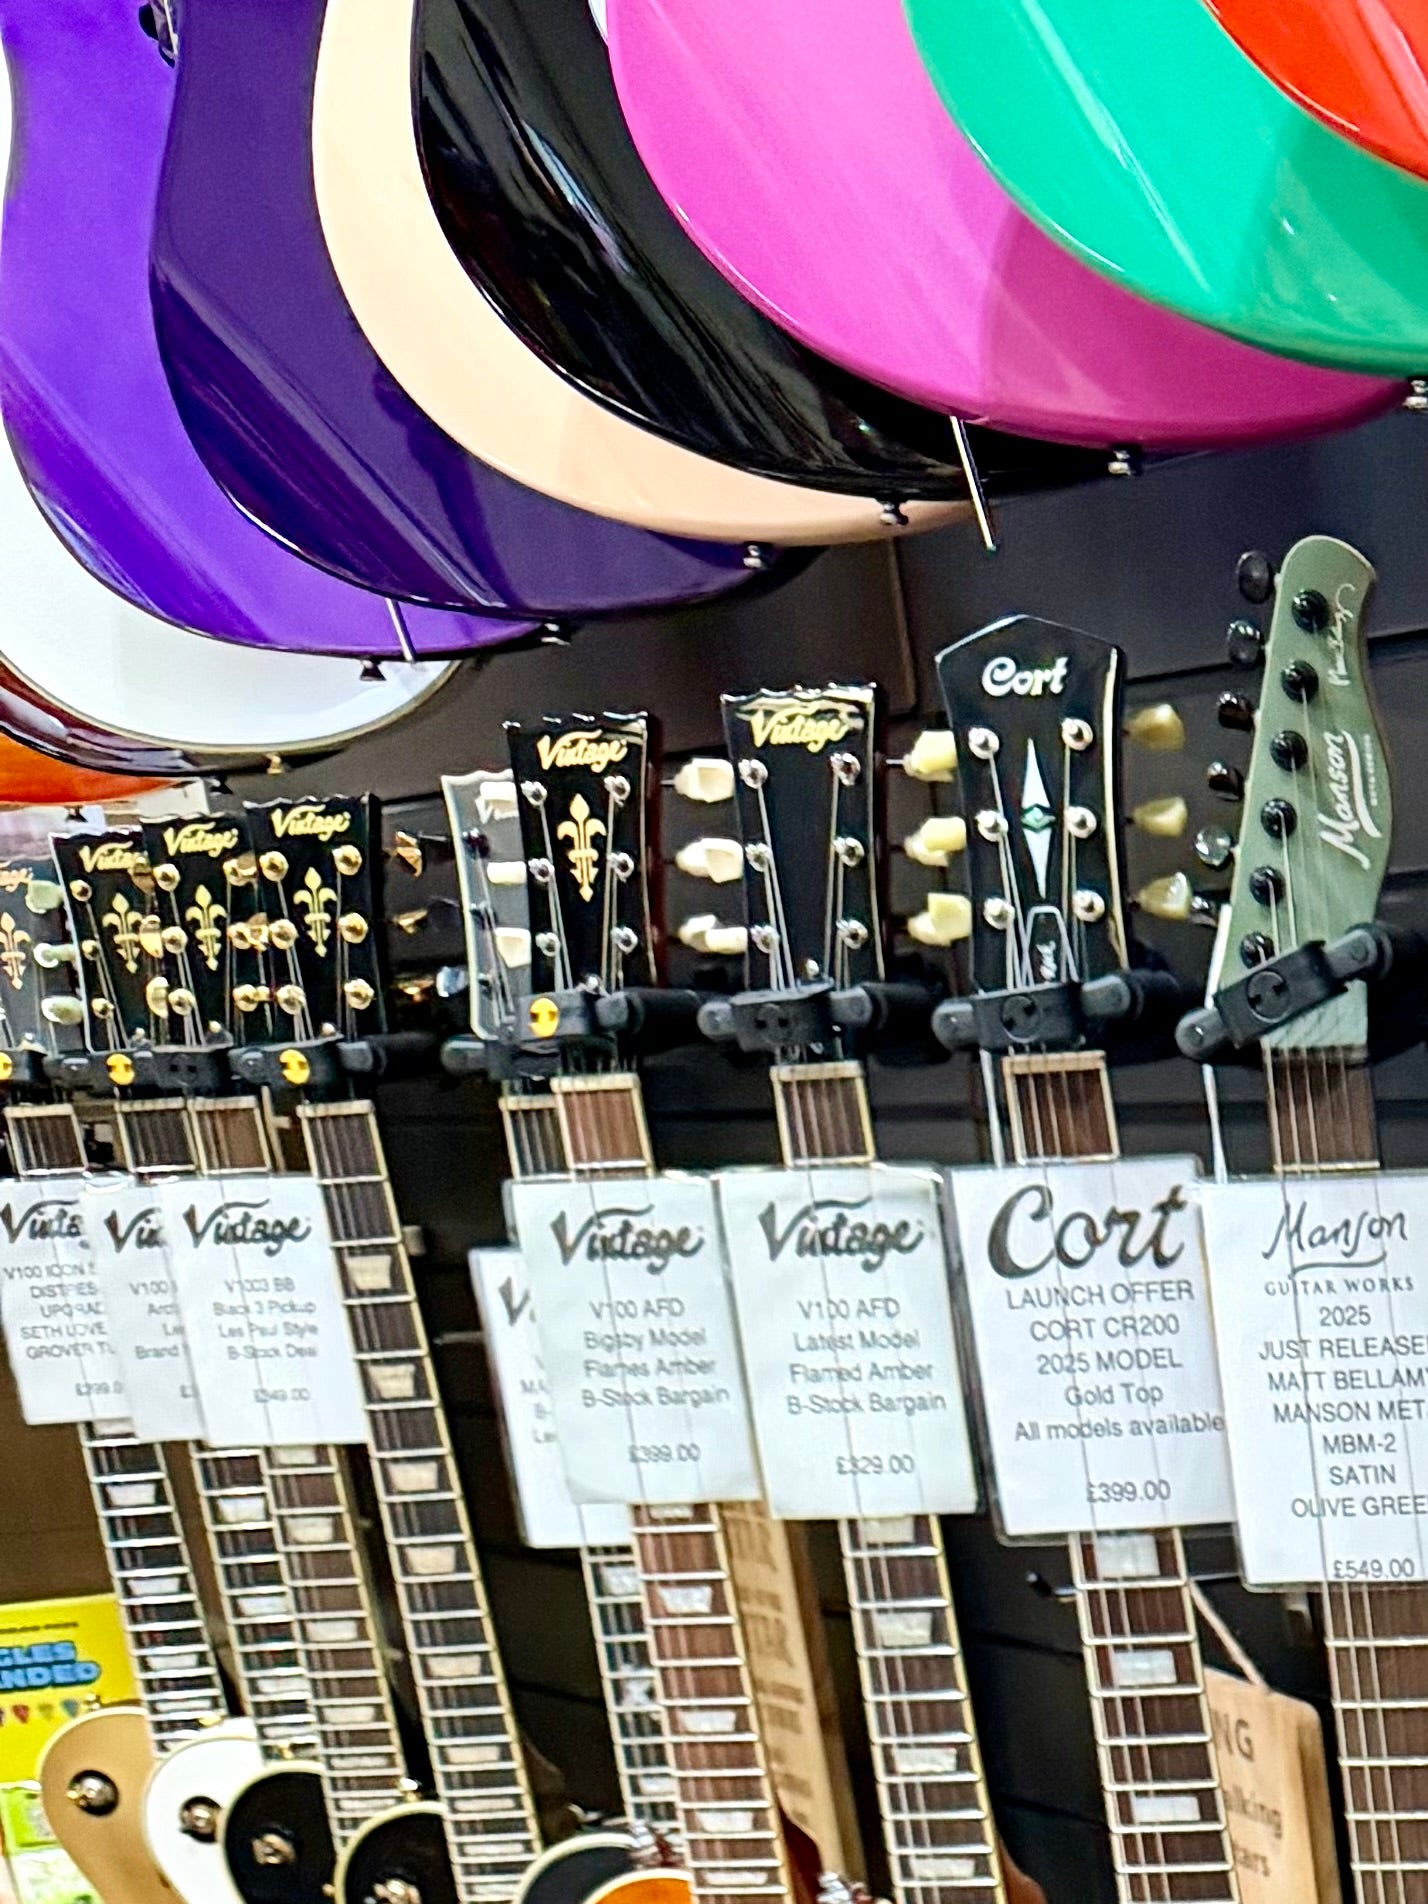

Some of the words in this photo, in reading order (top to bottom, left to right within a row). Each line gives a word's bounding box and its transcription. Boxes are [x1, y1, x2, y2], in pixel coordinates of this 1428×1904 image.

[982, 656, 1067, 699] Cort
[748, 707, 848, 754] Vintage
[536, 730, 629, 774] Vintage
[1317, 731, 1370, 870] Manson
[271, 805, 350, 840] Vintage
[163, 822, 239, 857] Vintage
[183, 1199, 311, 1257] Vintage
[551, 1204, 704, 1276] Vintage
[758, 1196, 925, 1273] Vintage
[988, 1184, 1188, 1279] Cort
[1262, 1201, 1408, 1260] Manson
[1006, 1284, 1105, 1311] LAUNCH
[1111, 1280, 1194, 1304] OFFER
[1264, 1277, 1338, 1297] GUITAR
[1346, 1276, 1414, 1294] WORKS
[1030, 1318, 1095, 1342] CORT
[1104, 1314, 1180, 1338] CR200
[1319, 1305, 1371, 1327] 2025
[1037, 1351, 1090, 1375] 2025
[1096, 1348, 1183, 1371] MODEL
[1259, 1340, 1312, 1362] JUST
[1065, 1386, 1114, 1407] Gold
[1123, 1383, 1164, 1406] Top
[1268, 1371, 1326, 1393] MATT
[1274, 1402, 1371, 1424] MANSON
[1015, 1421, 1040, 1441] All
[1047, 1419, 1123, 1440] models
[1130, 1414, 1224, 1437] available
[1323, 1433, 1397, 1455] MBM-2
[1329, 1465, 1397, 1487] SATIN
[1087, 1479, 1171, 1504] £399.00
[1291, 1496, 1355, 1518] OLIVE
[1333, 1557, 1416, 1579] £549.00
